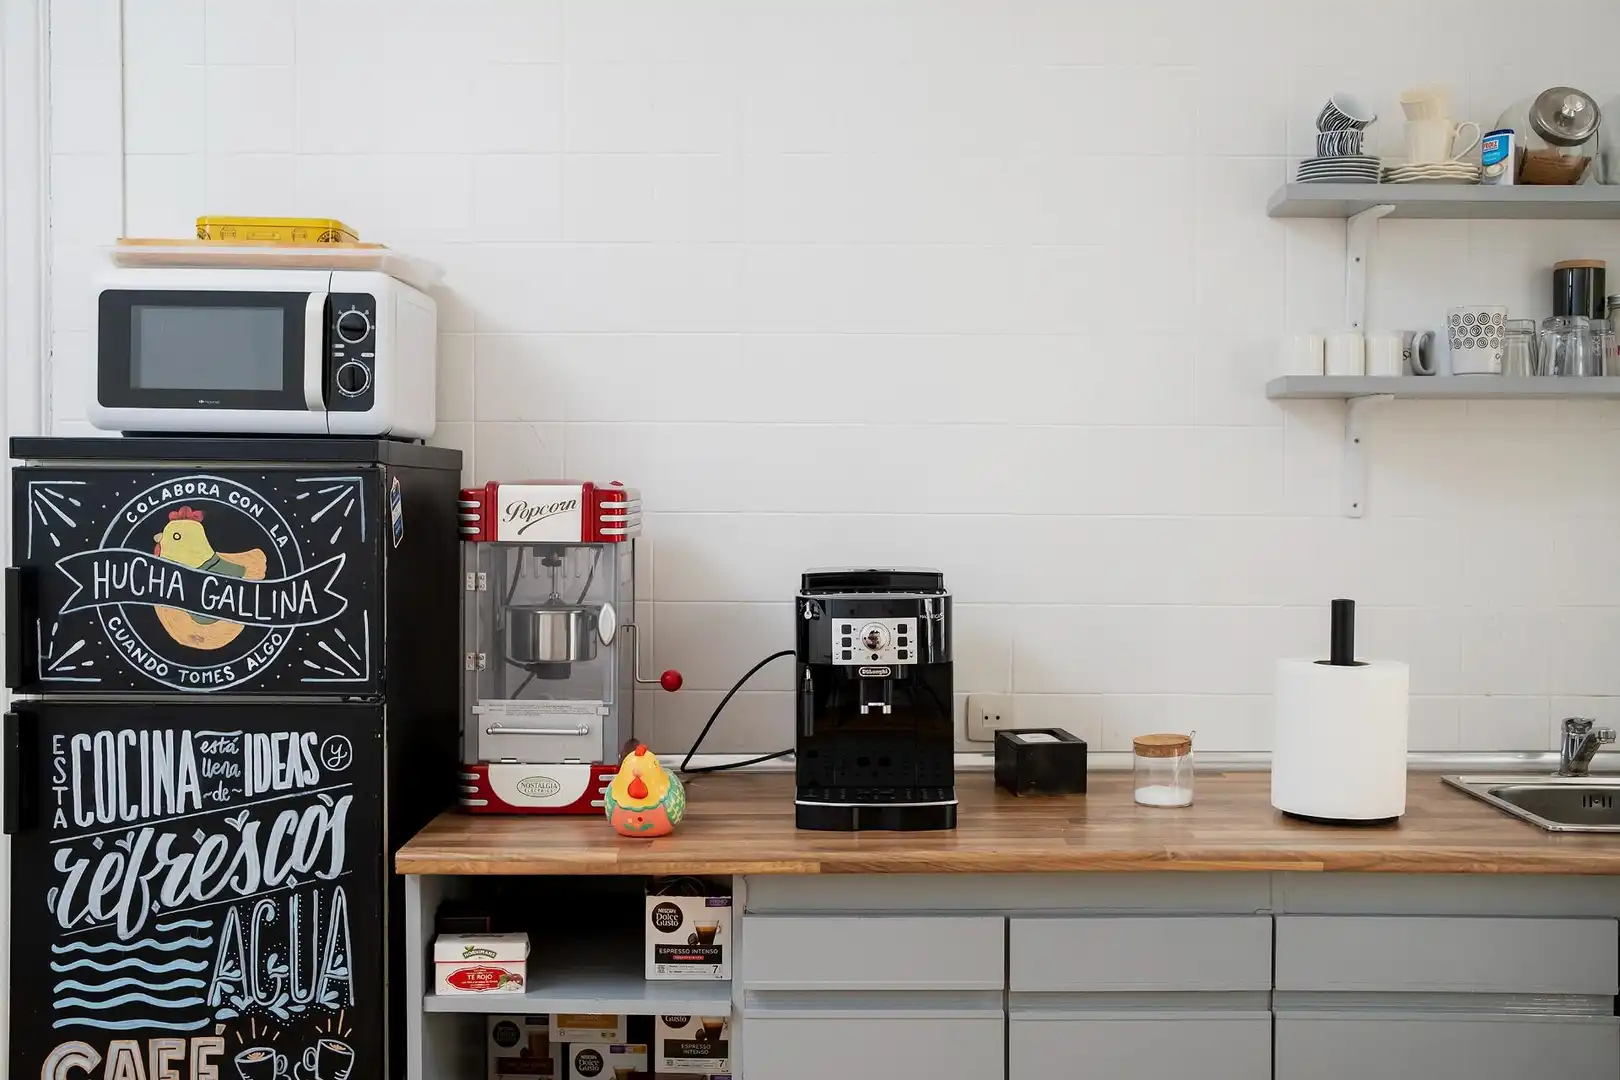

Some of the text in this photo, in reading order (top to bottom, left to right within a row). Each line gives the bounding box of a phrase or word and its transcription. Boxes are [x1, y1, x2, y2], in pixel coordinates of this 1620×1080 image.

[126, 482, 289, 548] COLABORA CON LA
[502, 498, 579, 525] Popcorn
[94, 556, 317, 620] HUCHA GALLINA
[108, 616, 284, 684] CUANDO TOMES ALGO
[200, 737, 240, 755] está
[202, 758, 242, 779] llena
[244, 731, 320, 796] IDEAS
[52, 729, 203, 829] ESTA COCINA
[53, 795, 354, 941] refrescos
[207, 886, 355, 1006] AGUA
[712, 965, 718, 973] 7
